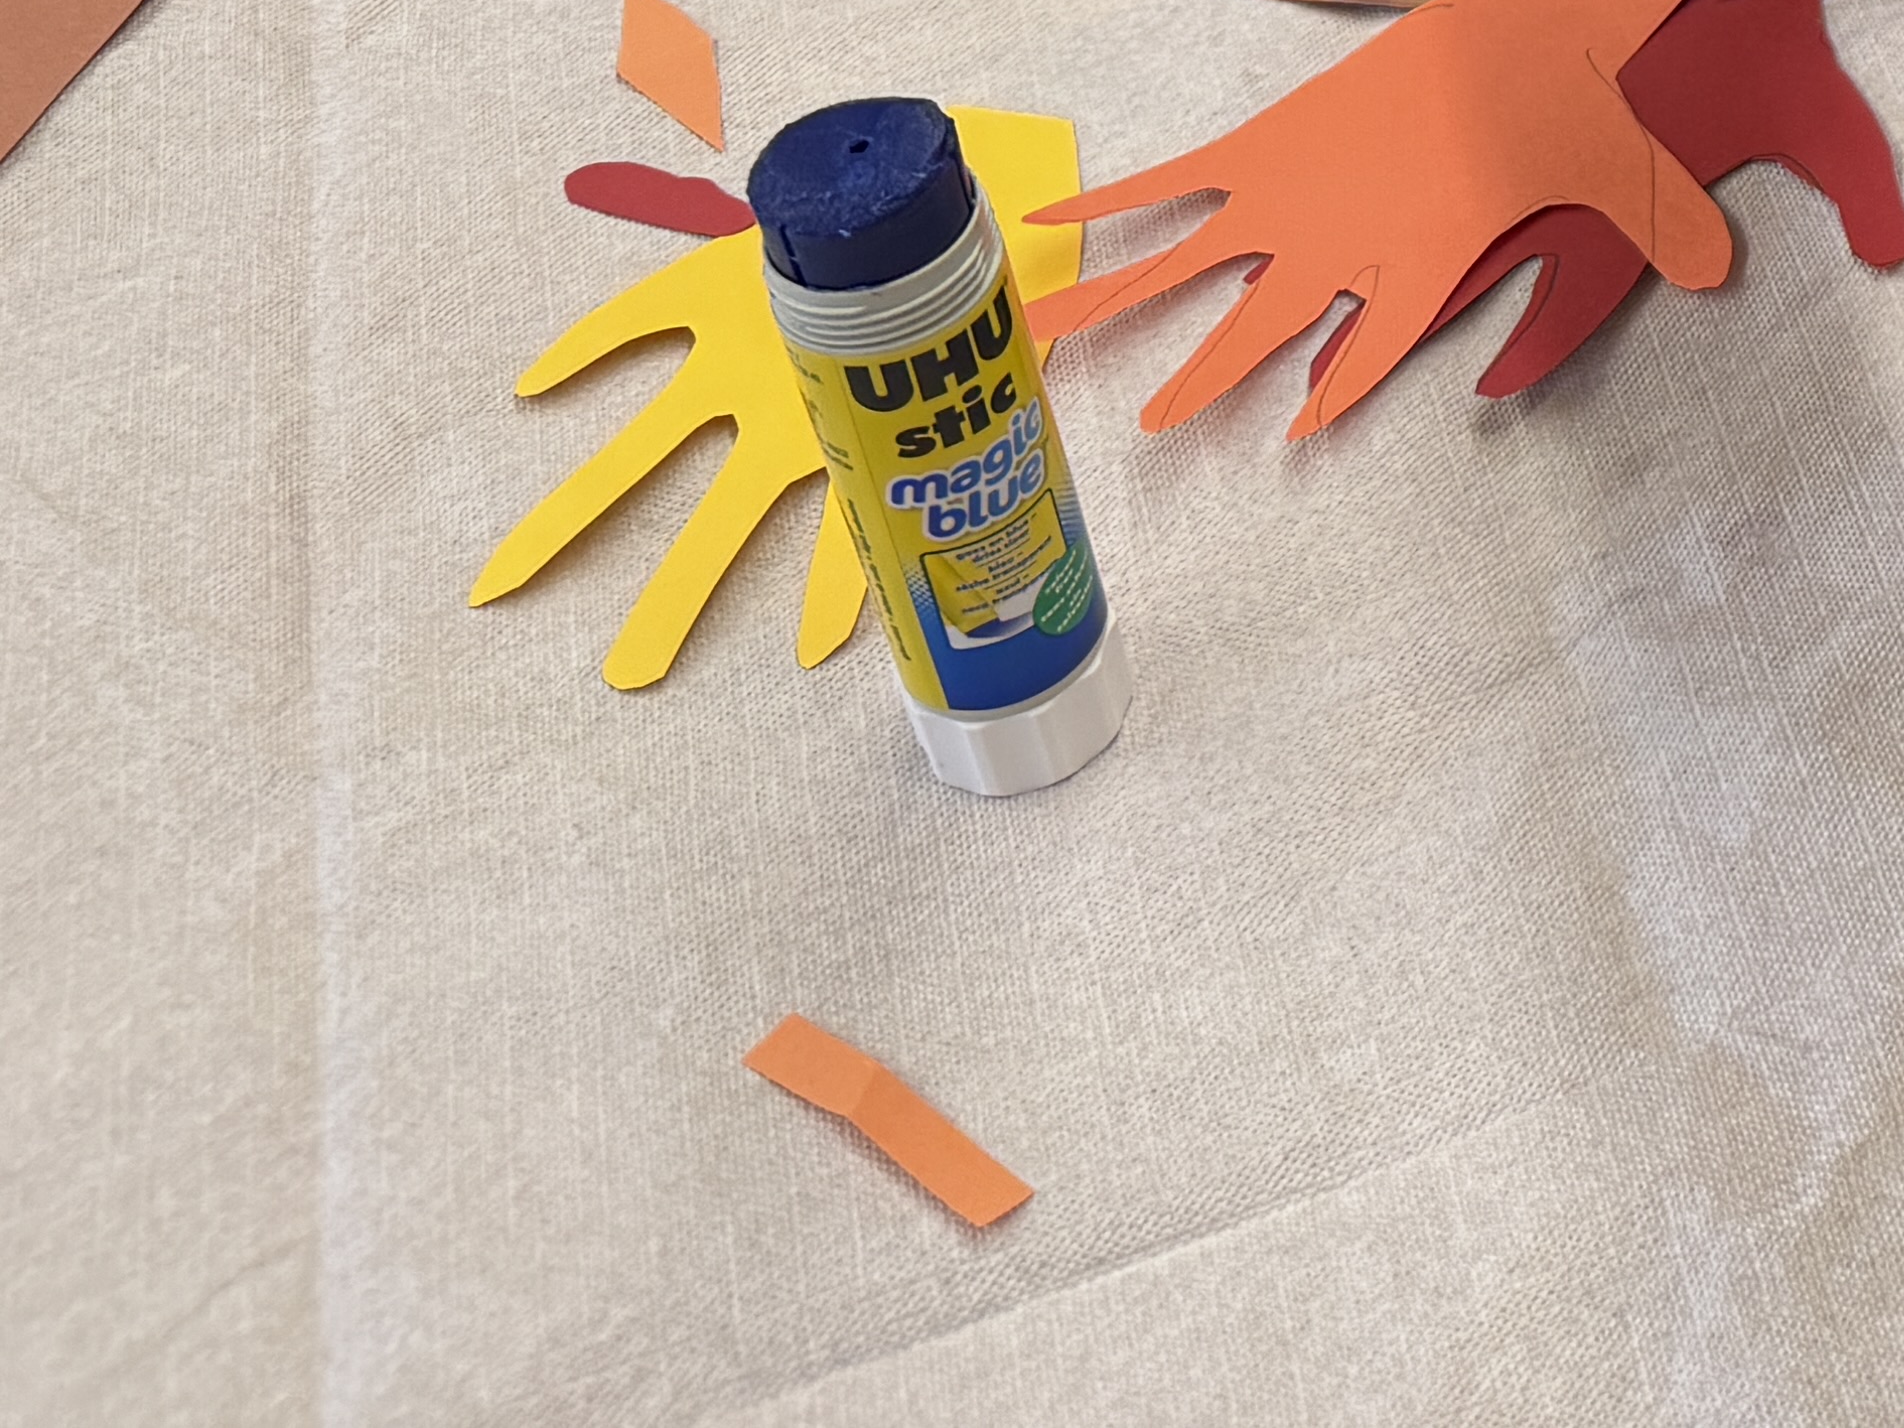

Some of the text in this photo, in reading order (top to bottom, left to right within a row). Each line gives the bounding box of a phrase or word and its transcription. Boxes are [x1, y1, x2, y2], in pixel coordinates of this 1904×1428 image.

[844, 285, 1013, 413] UHU
[889, 397, 1043, 507] magic
[895, 372, 1017, 458] stic
[927, 452, 1042, 539] blue
